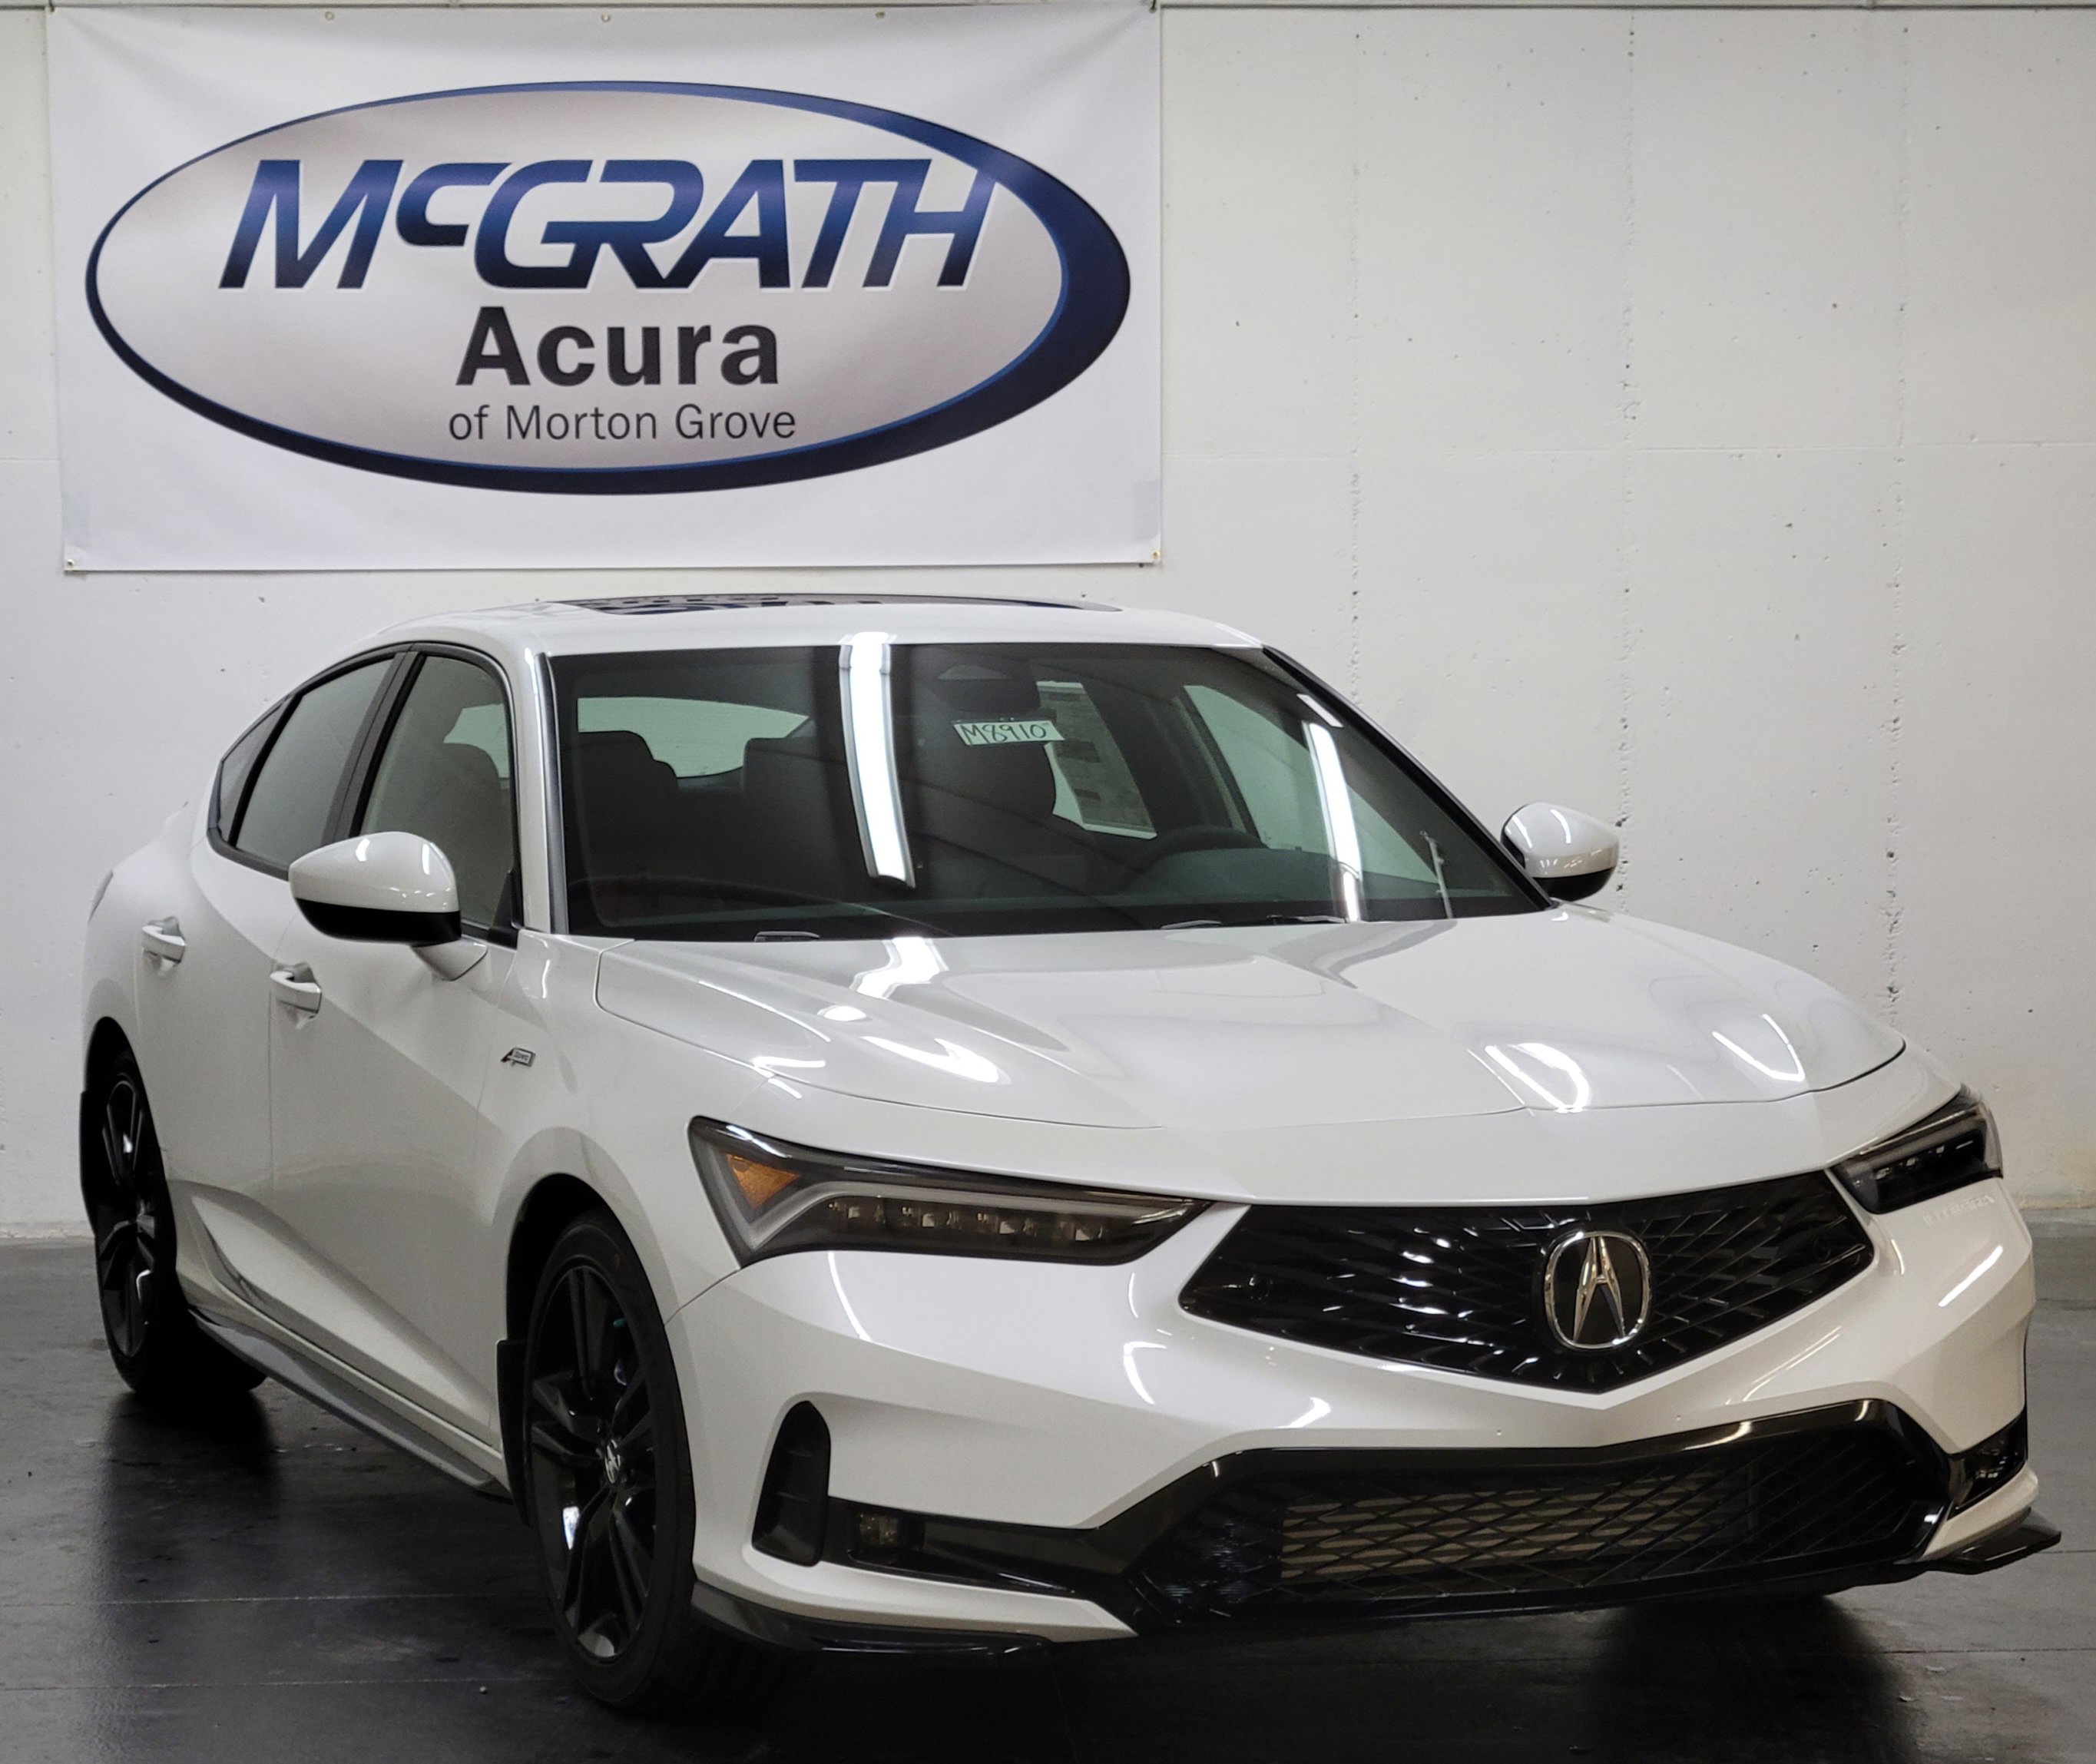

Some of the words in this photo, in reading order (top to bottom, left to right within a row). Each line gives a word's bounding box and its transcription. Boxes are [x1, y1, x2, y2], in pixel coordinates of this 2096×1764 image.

[219, 159, 997, 289] McGRATH
[455, 306, 779, 387] Acura
[449, 404, 490, 441] of
[506, 405, 657, 441] Morton
[675, 403, 796, 441] Grove
[959, 723, 1047, 744] M8910
